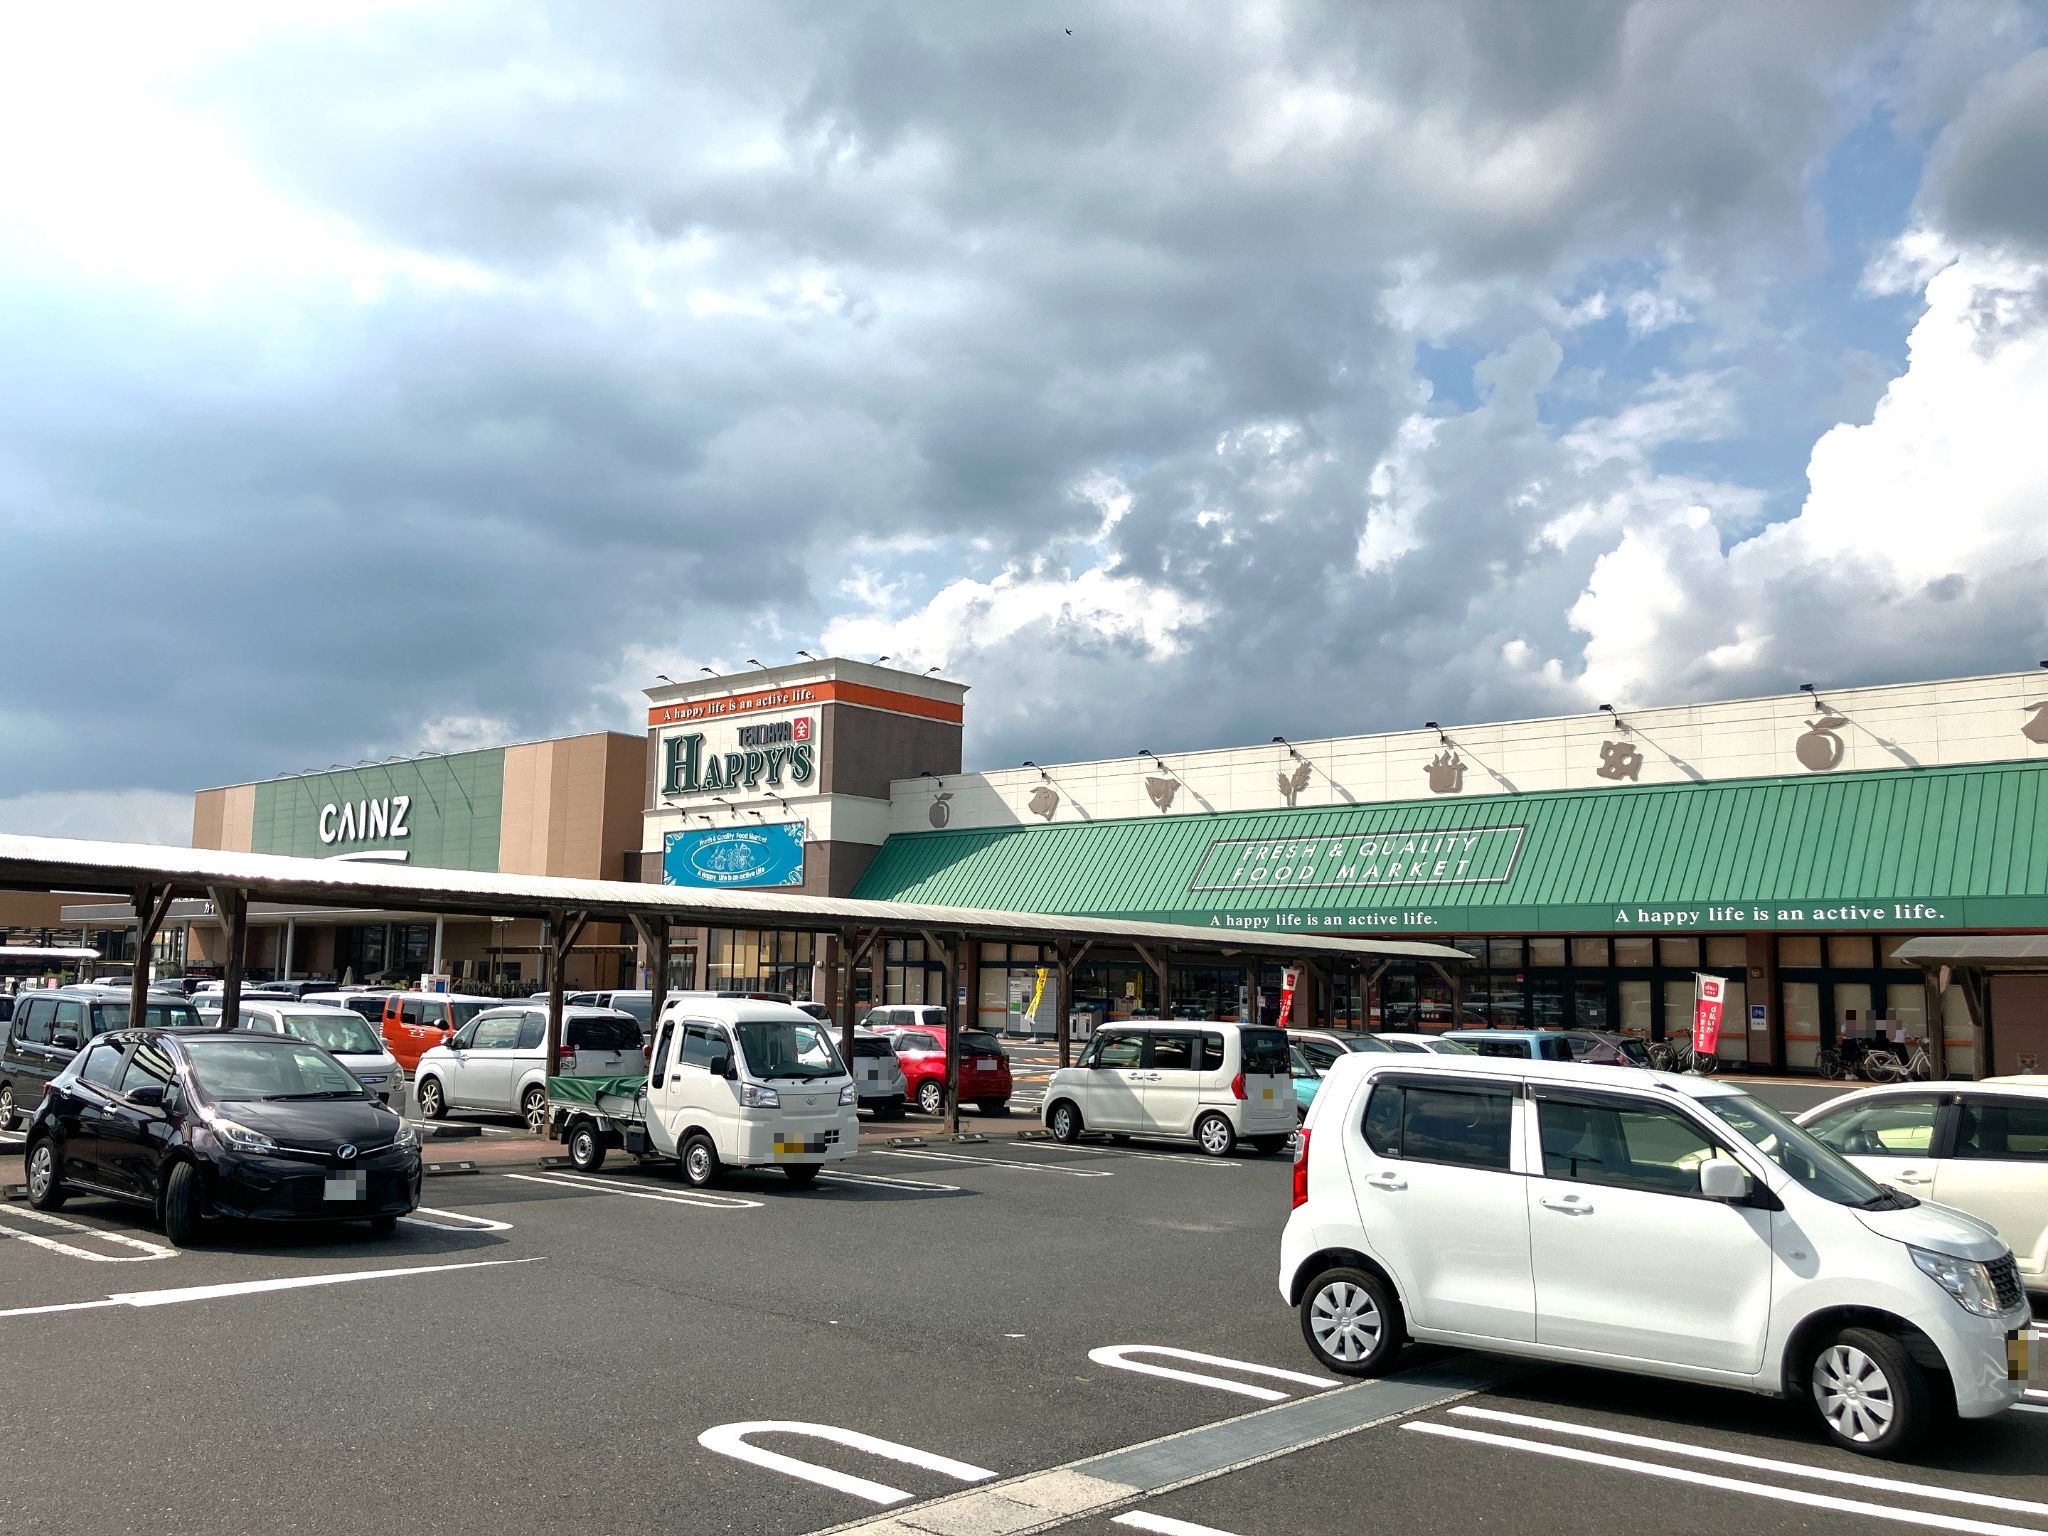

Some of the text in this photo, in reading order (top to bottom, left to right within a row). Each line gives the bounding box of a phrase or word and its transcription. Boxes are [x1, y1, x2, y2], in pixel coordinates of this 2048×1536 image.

[663, 688, 815, 720] A happy life is an active life.
[320, 795, 410, 843] CAINZ
[1242, 836, 1477, 861] FRESH & QUALITY
[1231, 860, 1470, 882] FOOD MARKET
[1210, 911, 1438, 929] A happy life is an active life.
[1615, 904, 1945, 926] A happy life is an active life.
